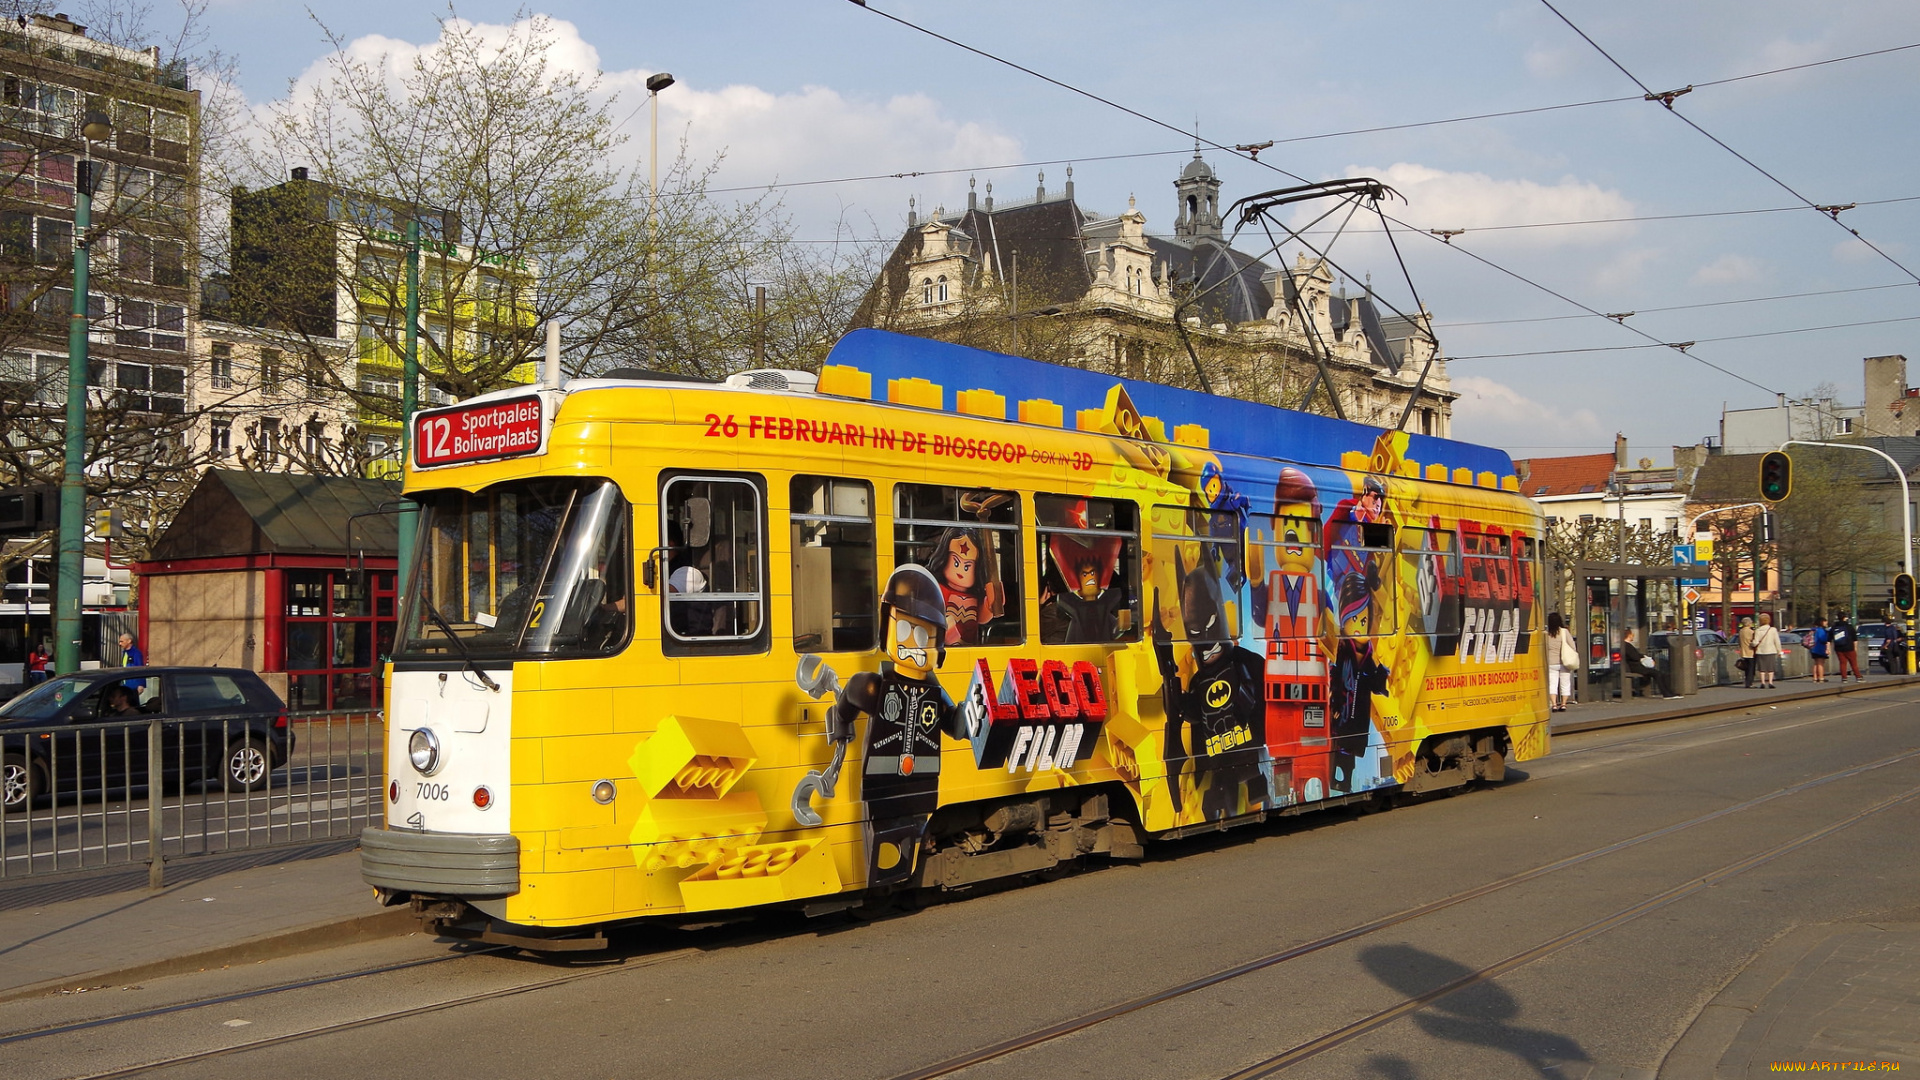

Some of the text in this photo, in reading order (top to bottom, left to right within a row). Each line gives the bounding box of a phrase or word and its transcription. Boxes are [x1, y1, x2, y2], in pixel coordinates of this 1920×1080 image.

[422, 402, 539, 459] 12 Sportpaleis
[454, 426, 539, 453] Bolivarplaats
[704, 413, 1093, 471] 26 FEBRUARI IN DE BIOSCOOP OOK IN 3D
[1428, 513, 1534, 603] LEGO
[1697, 546, 1710, 554] 50
[530, 602, 545, 628] 2
[1460, 607, 1520, 664] FILM
[976, 657, 1107, 726] LEGO
[1426, 678, 1434, 691] 26
[1436, 675, 1467, 690] FEBRUARI
[1469, 674, 1477, 687] IN
[1478, 673, 1486, 686] DE
[1488, 671, 1519, 685] BIOSCOOP
[1383, 715, 1399, 727] 7006
[1008, 723, 1084, 774] FILM
[416, 782, 449, 801] 7006
